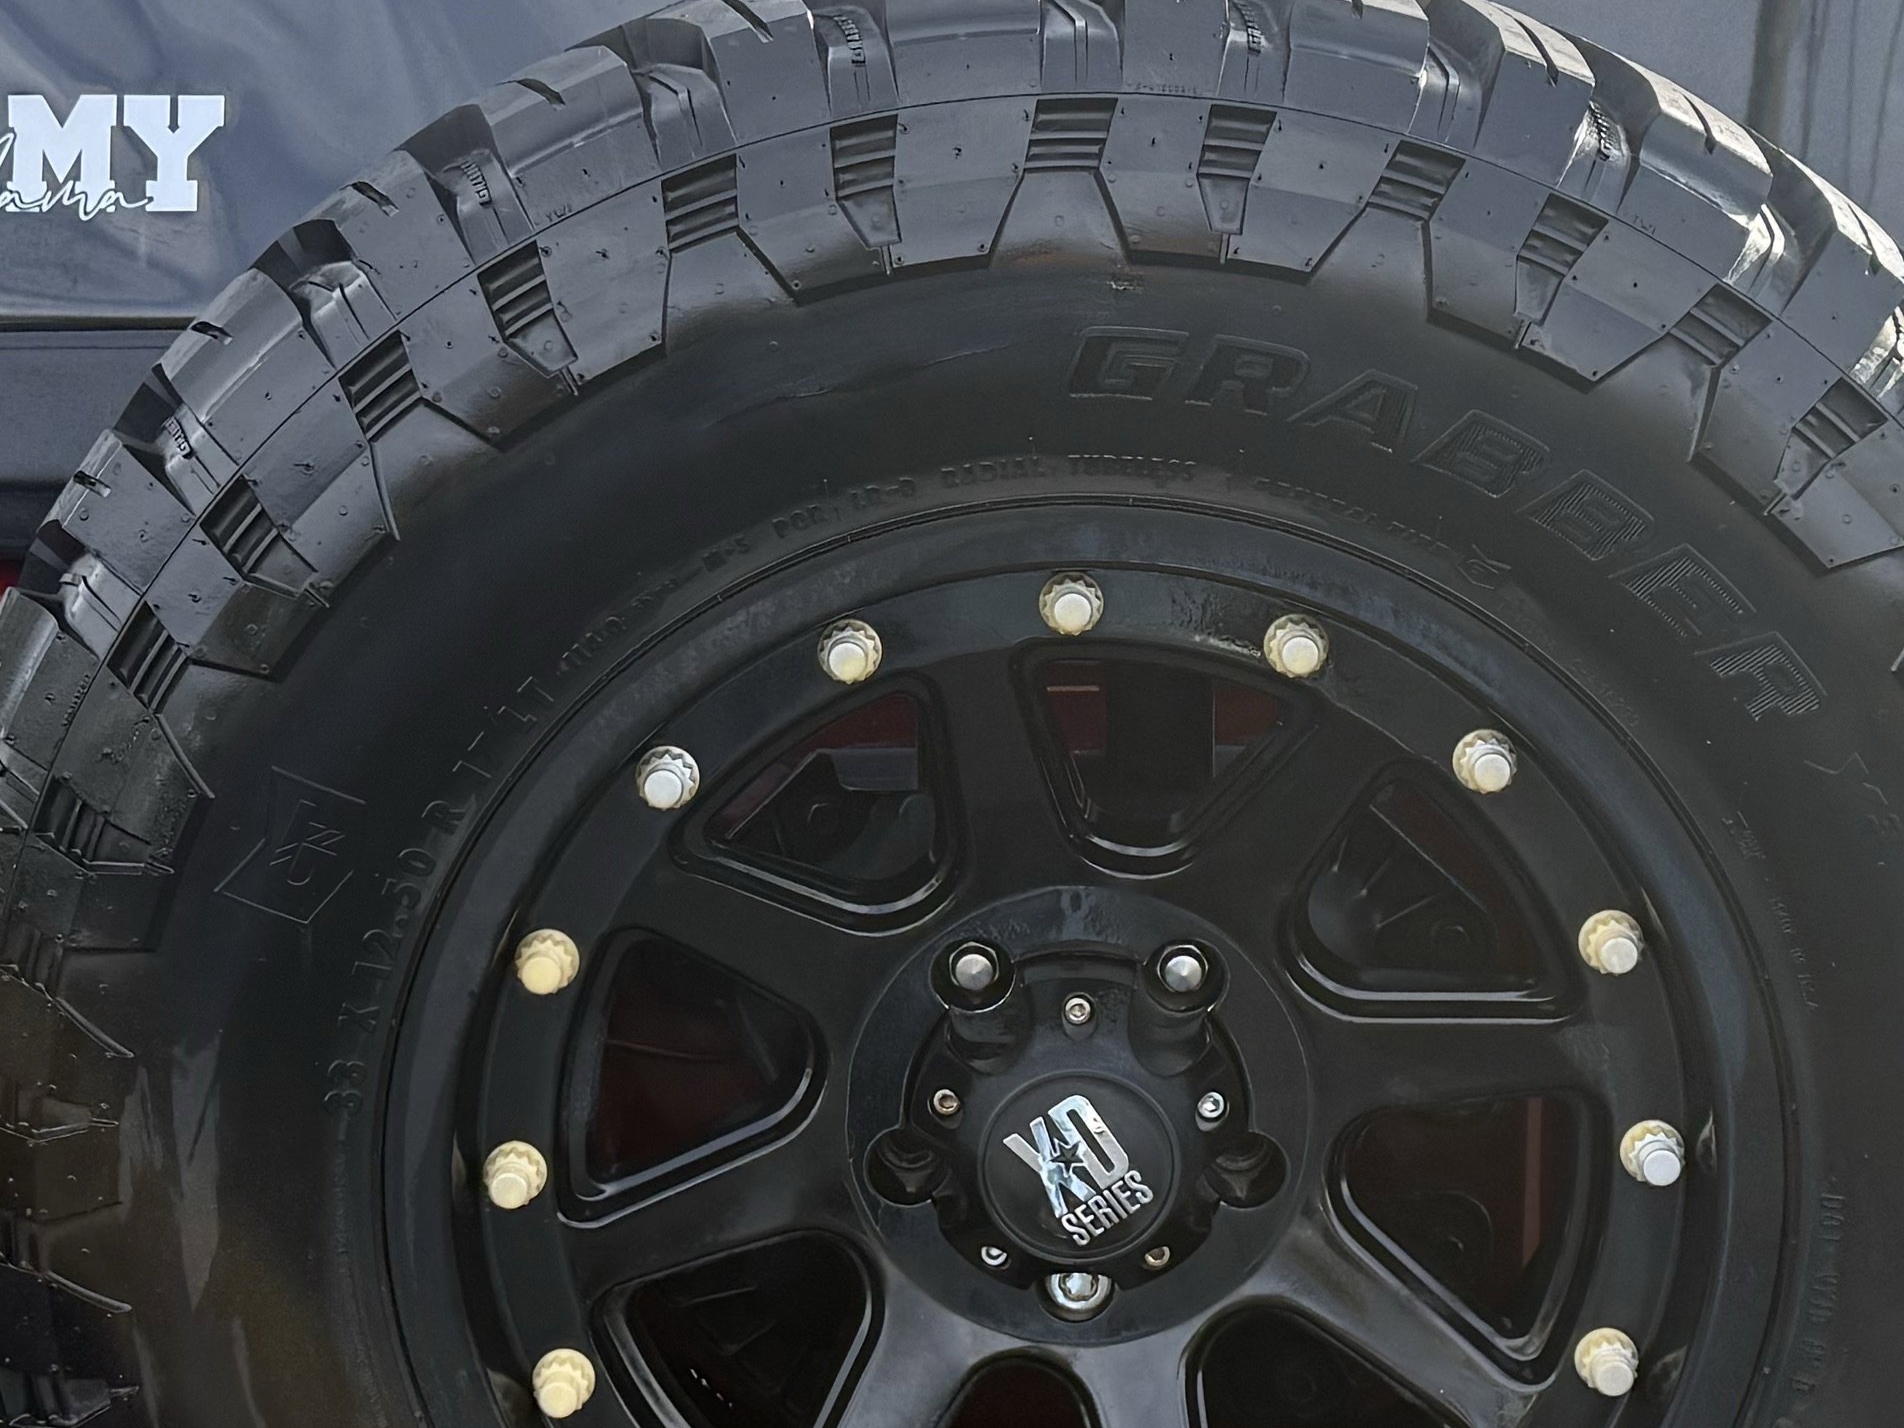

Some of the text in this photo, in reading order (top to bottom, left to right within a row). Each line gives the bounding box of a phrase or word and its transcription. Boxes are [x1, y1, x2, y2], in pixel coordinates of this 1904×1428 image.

[1070, 324, 1829, 724] GRABBER
[1003, 1095, 1129, 1218] XD
[1061, 1170, 1154, 1246] SERIES
